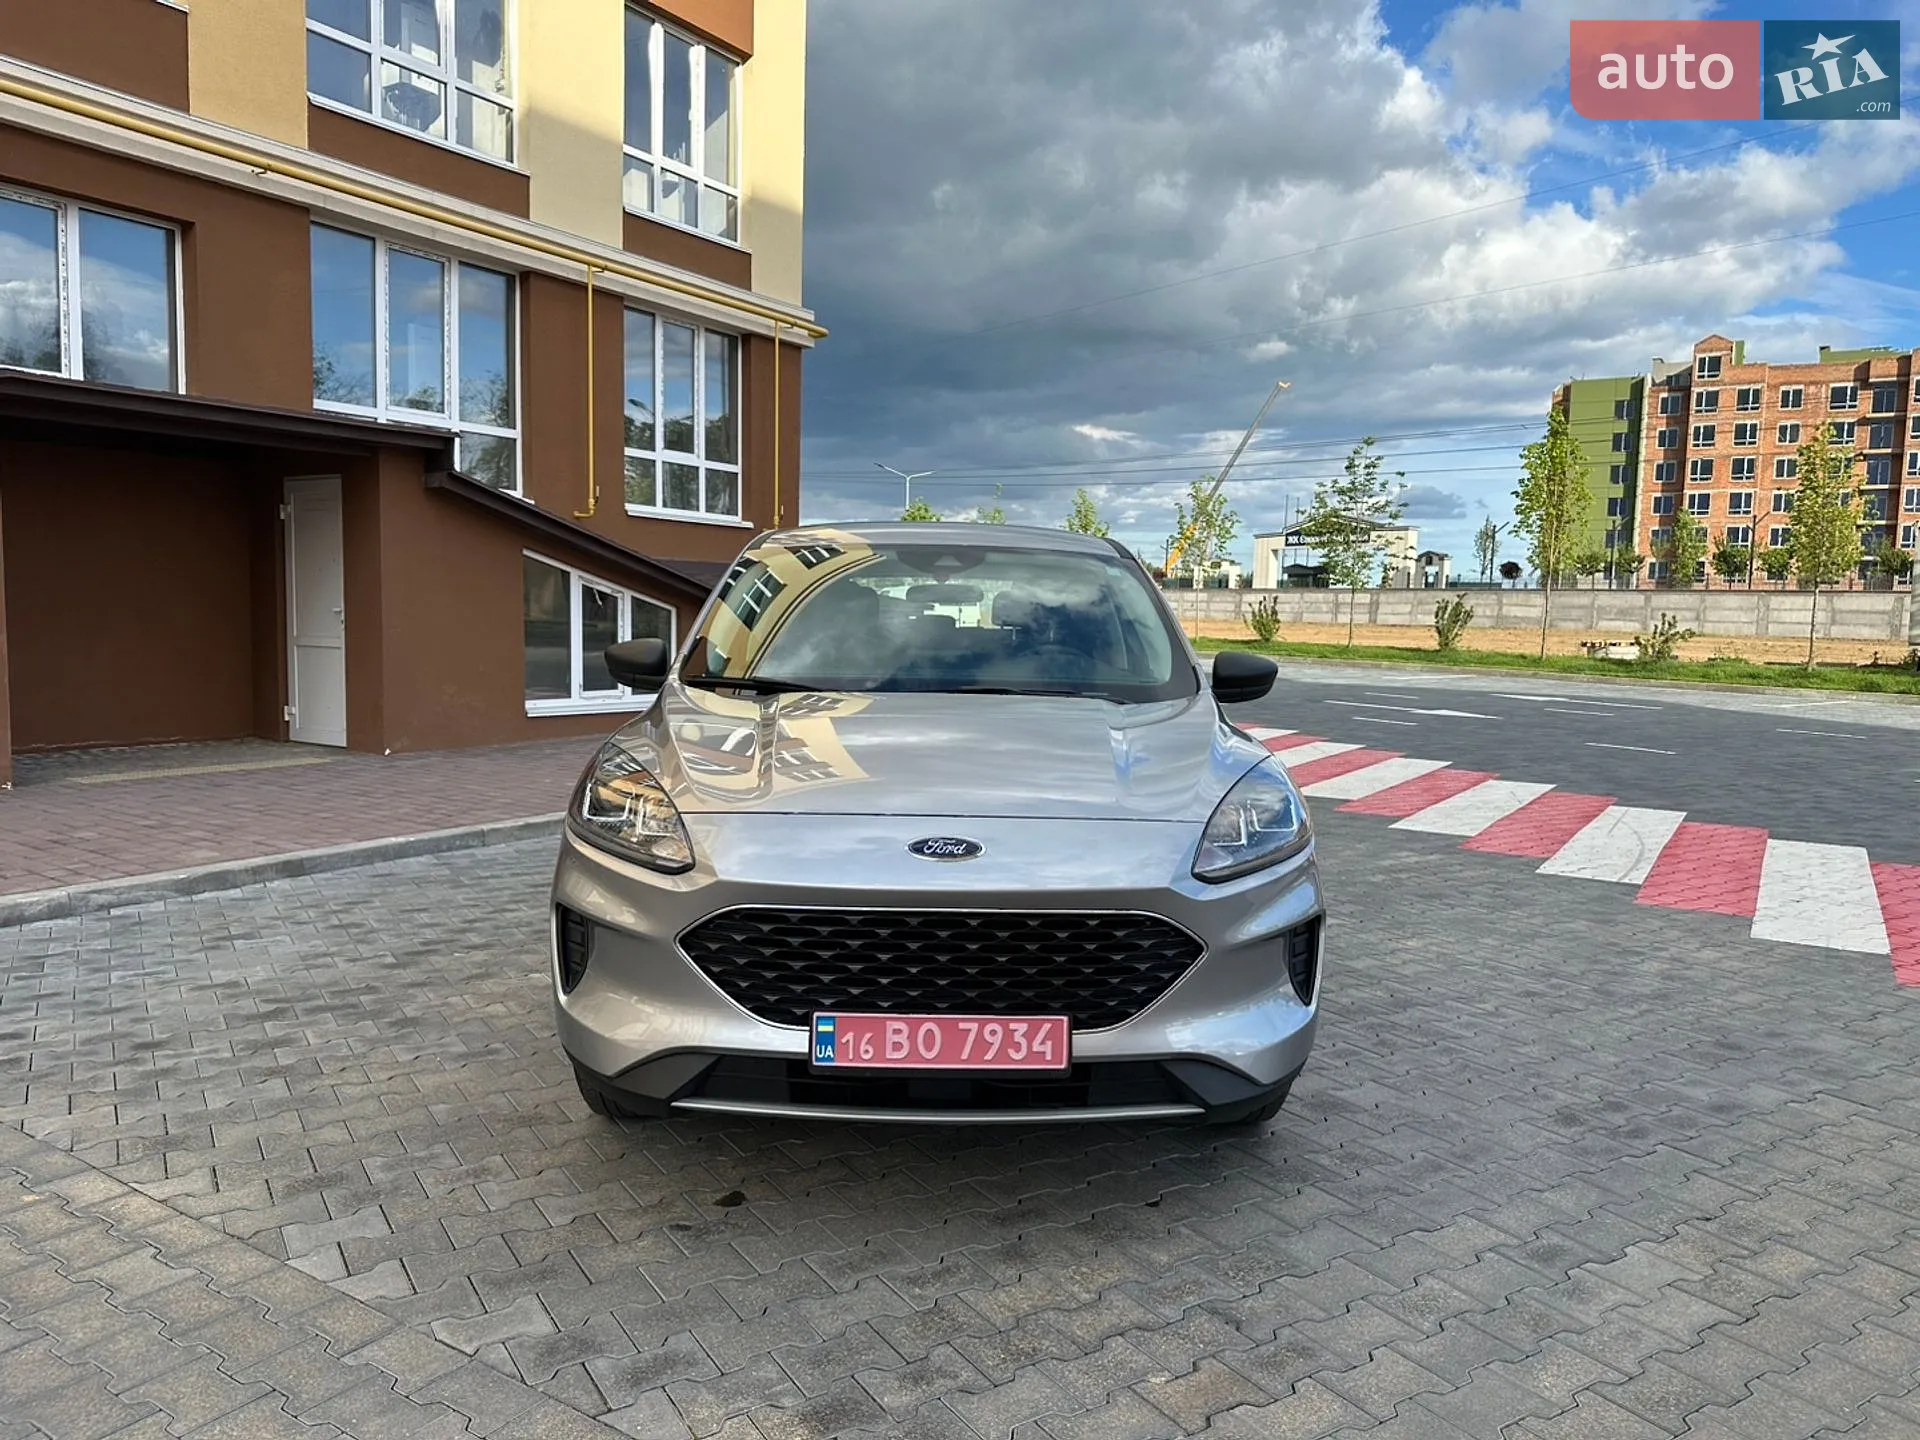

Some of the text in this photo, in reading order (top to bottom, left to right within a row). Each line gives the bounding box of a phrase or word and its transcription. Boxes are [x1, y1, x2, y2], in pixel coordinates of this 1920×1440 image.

[923, 839, 967, 854] Ford
[840, 1020, 1052, 1062] 16 BO 7934
[816, 1045, 834, 1058] UA
